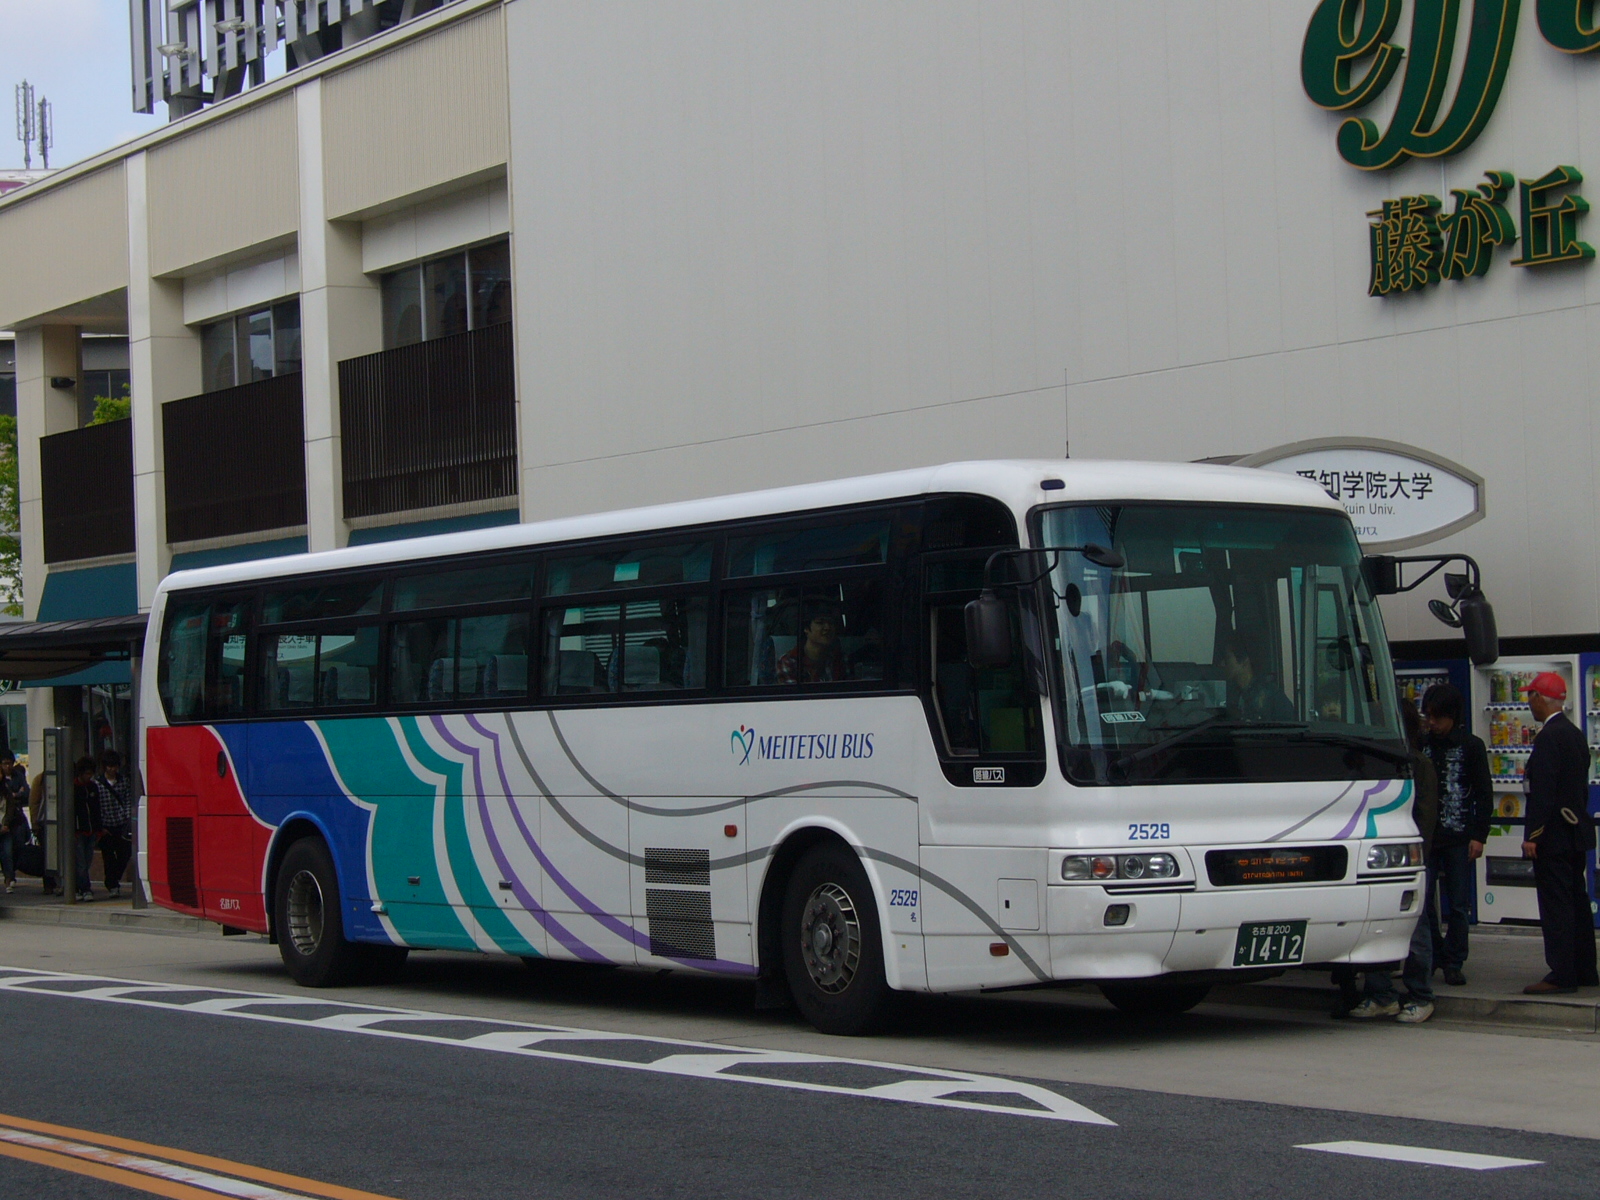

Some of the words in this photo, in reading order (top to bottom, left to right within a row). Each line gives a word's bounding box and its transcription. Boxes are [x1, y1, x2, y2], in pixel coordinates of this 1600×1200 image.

[1366, 165, 1596, 298] 藤が丘
[1368, 503, 1397, 515] Univ.
[757, 733, 839, 760] MEITETSU
[841, 732, 875, 759] BUS
[1128, 823, 1170, 840] 2529
[890, 889, 918, 907] 2529
[910, 912, 917, 922] 名
